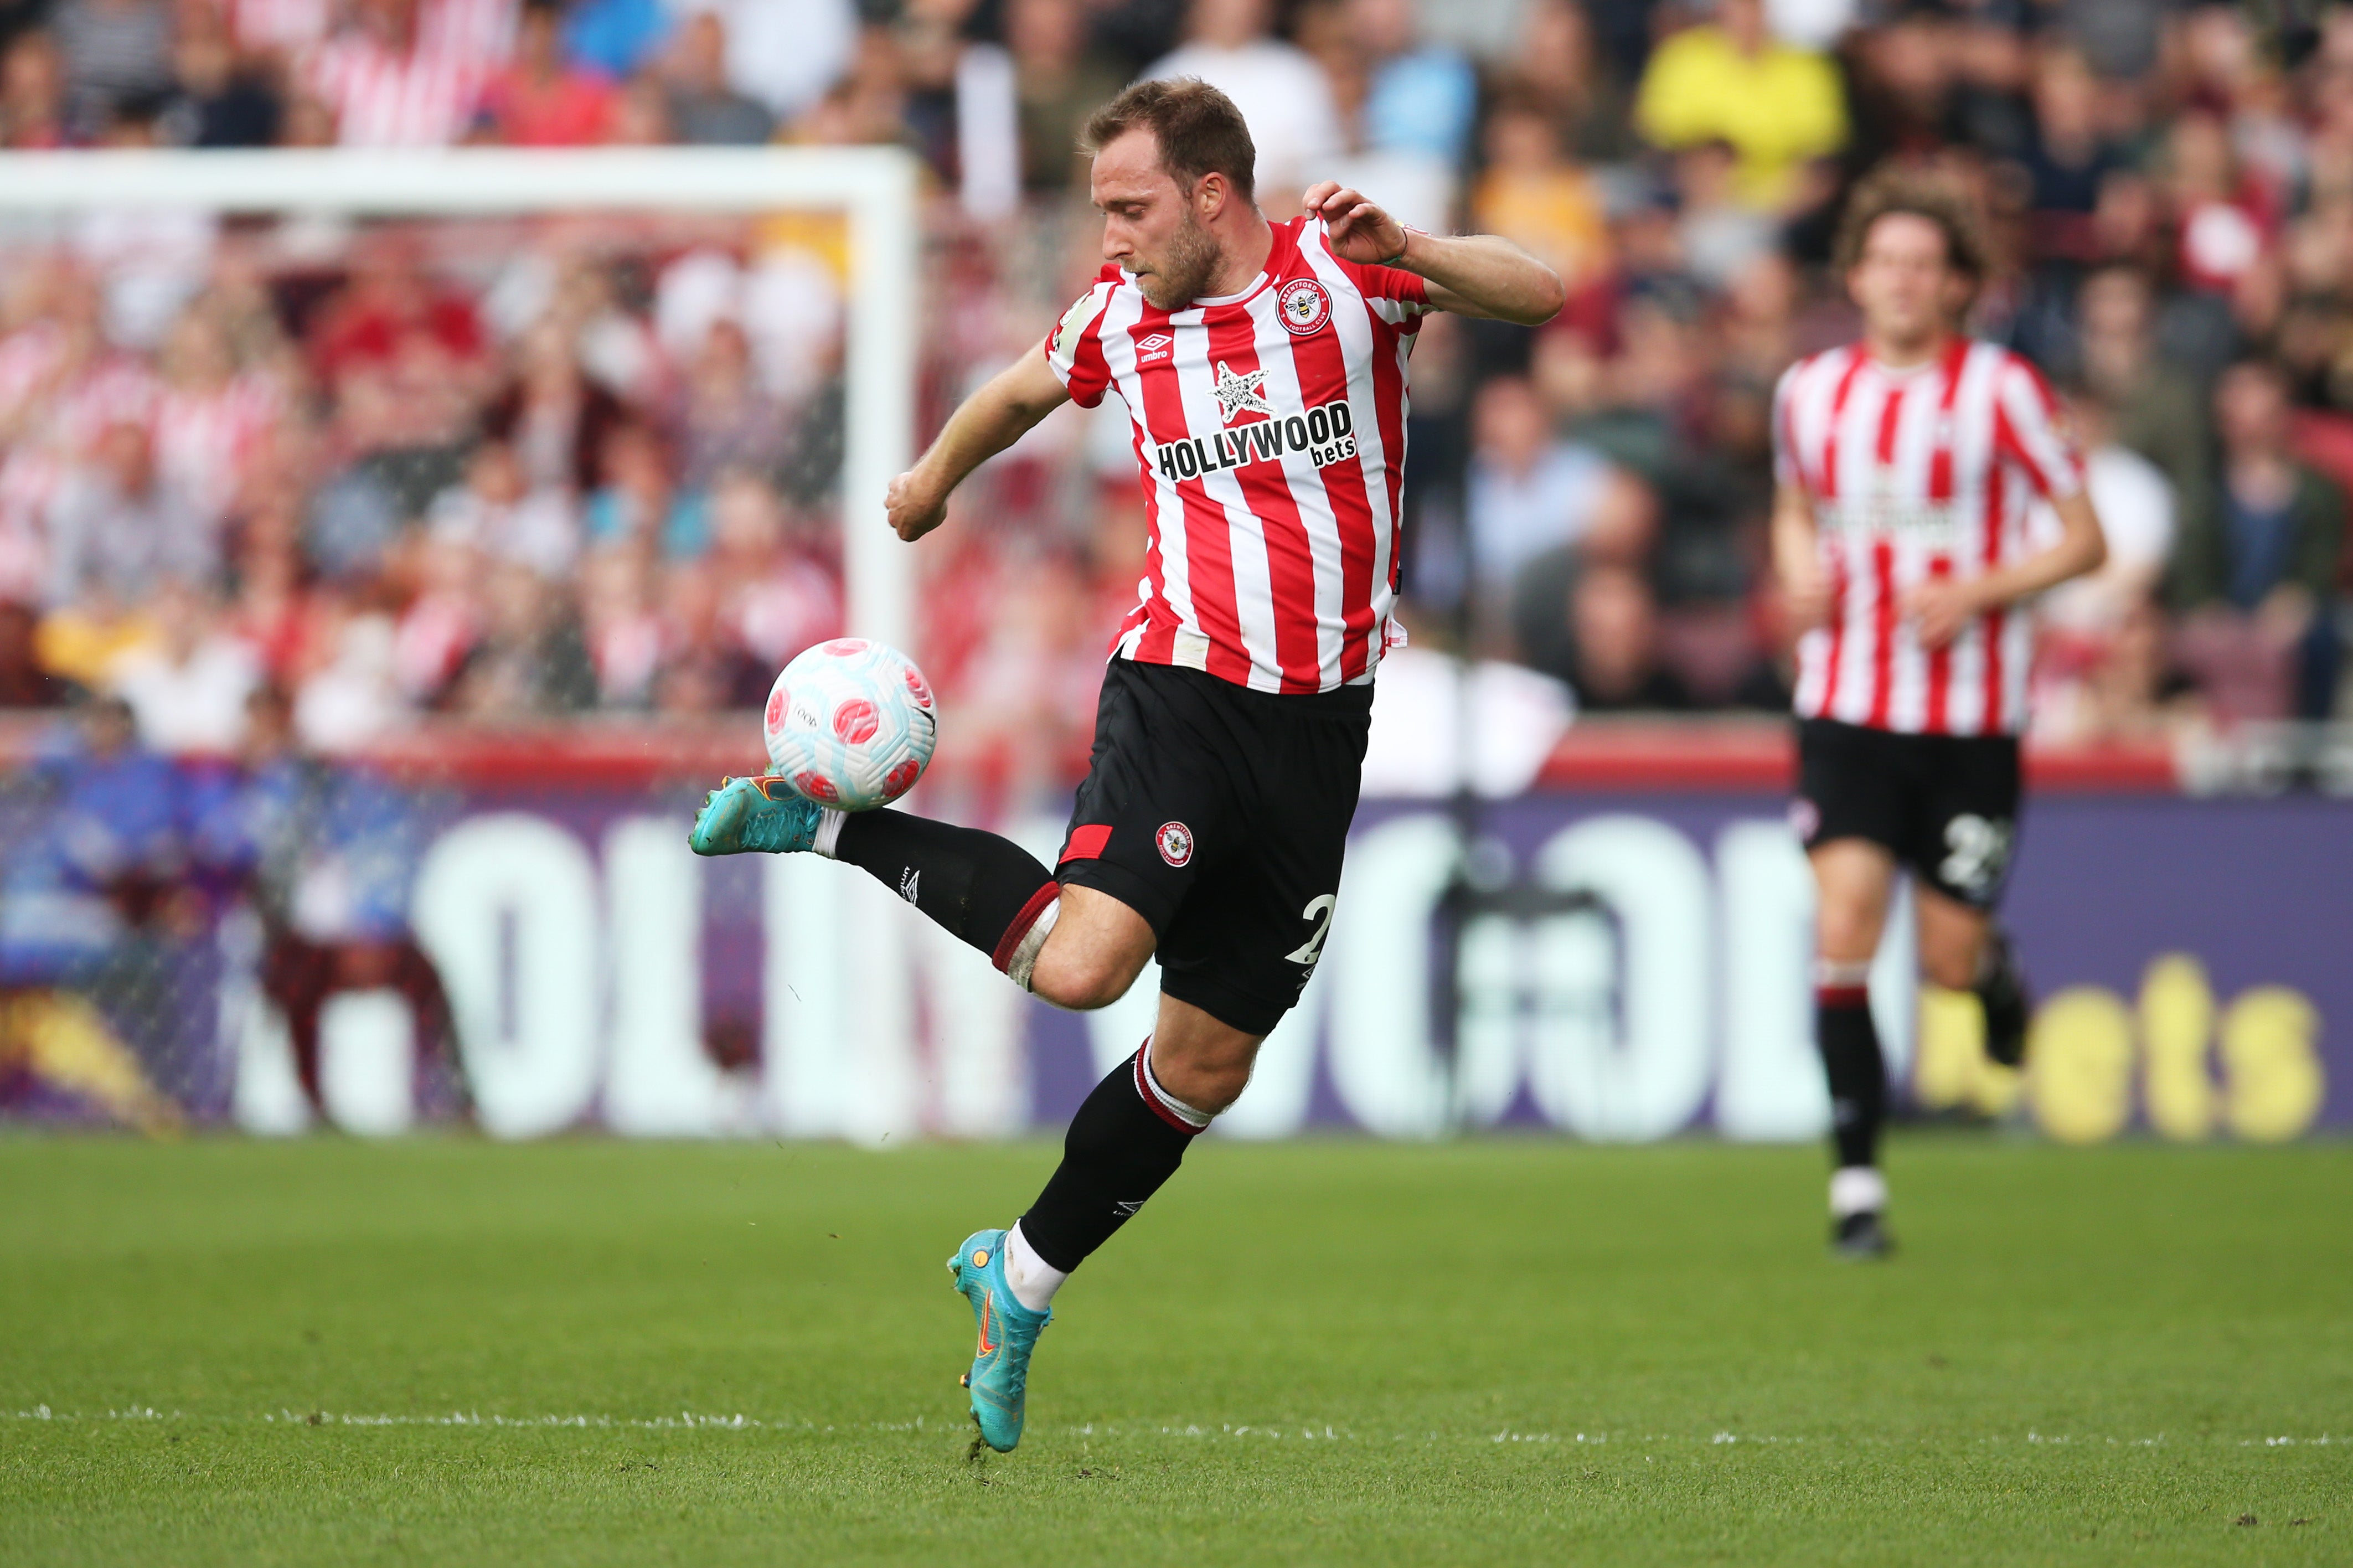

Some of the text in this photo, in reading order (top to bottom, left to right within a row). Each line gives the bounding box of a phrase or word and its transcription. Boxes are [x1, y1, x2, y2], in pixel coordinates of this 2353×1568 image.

[1281, 282, 1317, 303] BRENTFORD
[1315, 312, 1327, 325] CLUB
[1141, 350, 1168, 363] umbro
[1158, 402, 1352, 481] HOLLYWOOD
[1309, 439, 1355, 467] bets
